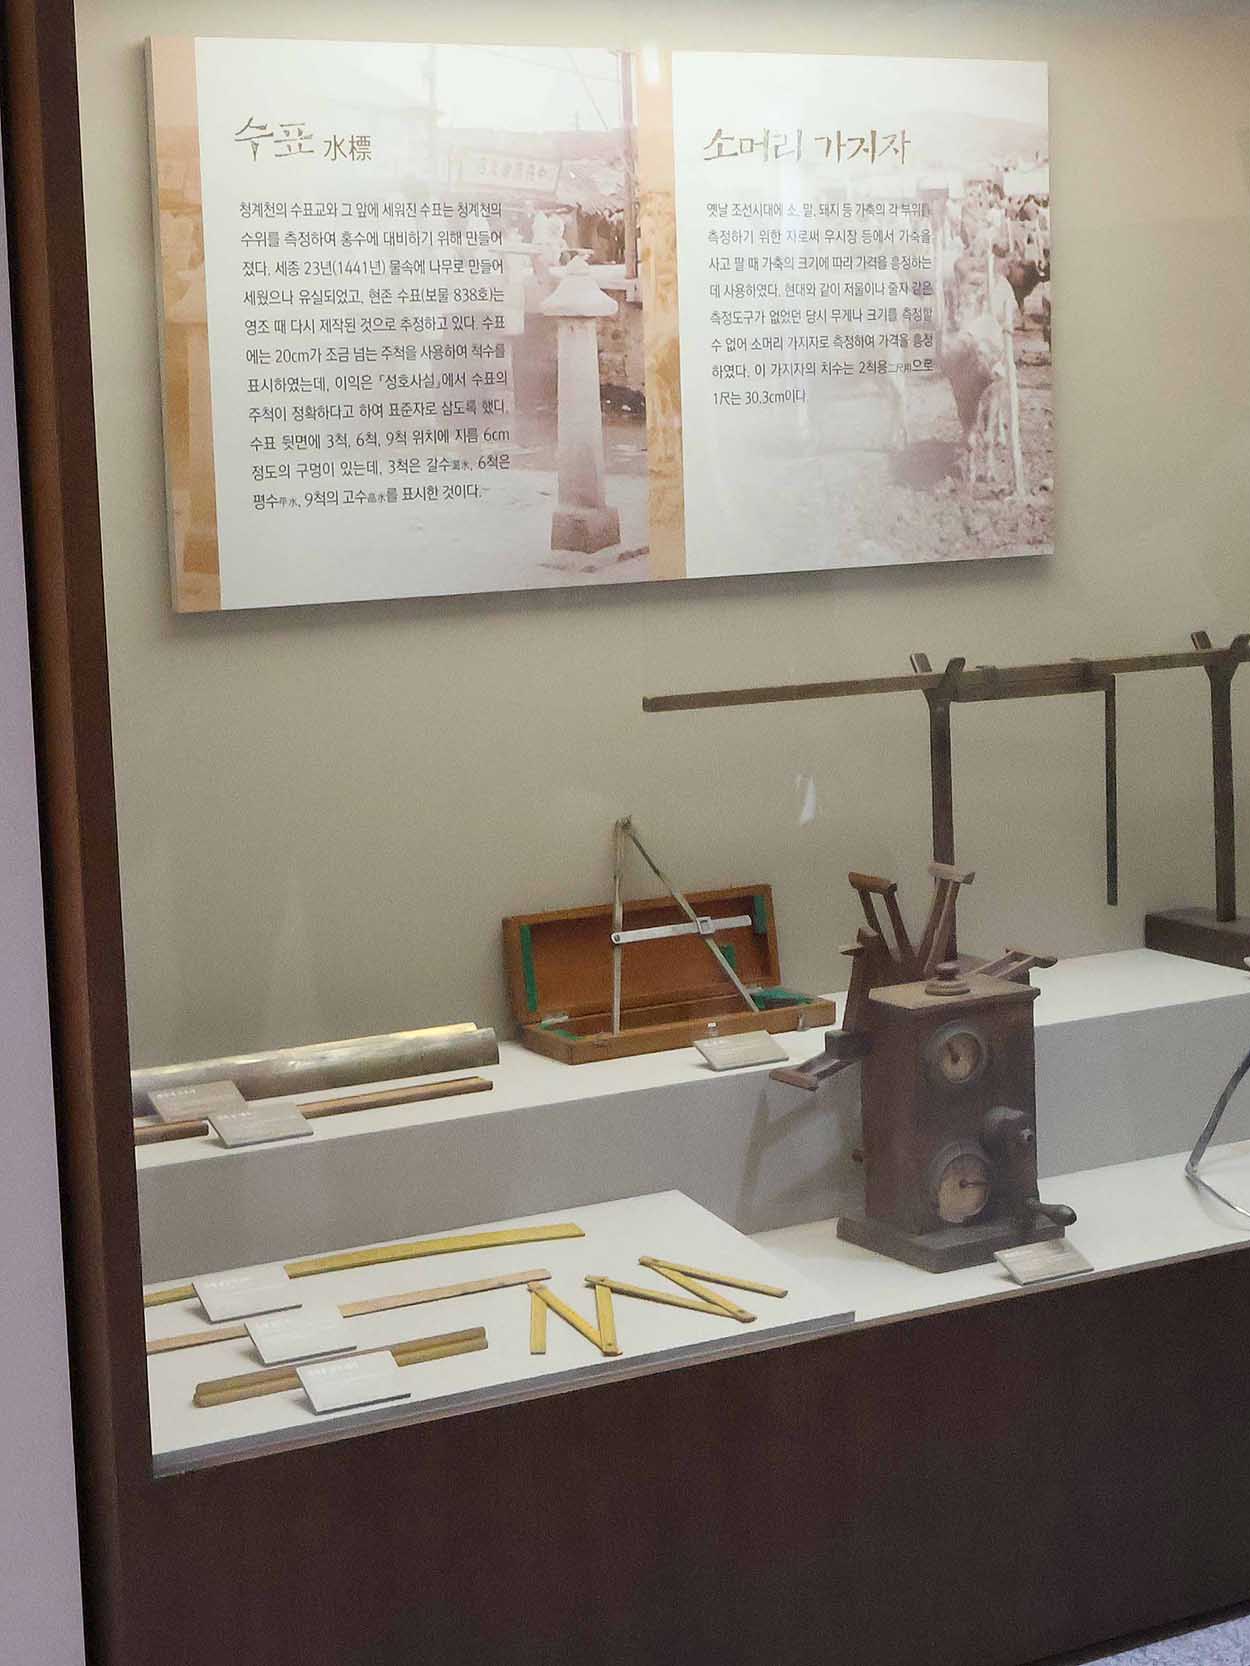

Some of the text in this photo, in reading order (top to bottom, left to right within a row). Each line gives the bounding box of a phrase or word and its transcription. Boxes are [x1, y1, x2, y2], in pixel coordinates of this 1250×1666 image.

[235, 116, 373, 162] 수표 水標
[703, 127, 912, 165] 소머리 가지자
[240, 201, 502, 218] 청계천의 수표교와 그 앞에 세워진 수표는 청계천의
[706, 203, 728, 217] 옛날
[731, 203, 783, 217] 조선시대에
[819, 203, 840, 217] 돼지
[842, 203, 852, 218] 등
[856, 203, 886, 218] 가축의
[889, 203, 898, 217] 각
[241, 231, 503, 248] 수위를 측정하여 홍수에 대비하기 위해 만들어
[708, 230, 754, 245] 측정하기
[760, 229, 781, 244] 위한
[824, 229, 857, 244] 우시장
[861, 229, 894, 244] 등에서
[242, 259, 503, 277] 졌다. 세종 23년(1441년) 물속에 나무로 만들어
[709, 257, 731, 271] 사고
[748, 257, 759, 271] 때
[762, 256, 794, 271] 가축의
[798, 256, 829, 271] 크기에
[856, 256, 887, 271] 가격을
[243, 289, 293, 306] 세웠으나
[369, 288, 392, 304] 현존
[397, 288, 449, 304] 수표(보물
[454, 288, 504, 303] 838호)는
[710, 284, 720, 298] 데
[785, 282, 816, 298] 현대와
[820, 282, 840, 297] 같이
[844, 282, 885, 297] 저울이나
[888, 281, 909, 297] 줄자
[245, 315, 505, 336] 영조 때 다시 제작된 것으로 추정하고 있다. 수표
[710, 310, 766, 326] 측정도구가
[769, 309, 801, 325] 없었던
[806, 308, 827, 324] 당시
[831, 308, 863, 323] 무게나
[711, 338, 722, 352] 수
[725, 337, 747, 352] 없어
[751, 336, 783, 351] 소머리
[788, 336, 830, 351] 가지자로
[833, 334, 875, 350] 측정하여
[246, 349, 271, 365] 에는
[275, 347, 321, 364] 20cm가
[326, 347, 349, 363] 조금
[353, 346, 377, 362] 넘는
[381, 344, 416, 361] 주척을
[420, 343, 468, 360] 사용하여
[712, 364, 750, 379] 하였다.
[754, 363, 765, 378] 이
[771, 362, 816, 377] 가지자의
[821, 361, 854, 376] 치수는
[335, 374, 373, 391] 이익은
[471, 371, 507, 387] 수표의
[713, 391, 742, 406] 1尺는
[249, 406, 287, 423] 주척이
[292, 404, 354, 422] 정확하다고
[359, 403, 383, 419] 하여
[388, 401, 436, 418] 표준자로
[250, 436, 276, 452] 수표
[282, 434, 321, 450] 뒷면에
[386, 430, 407, 446] 9척
[413, 429, 449, 445] 위치에
[455, 428, 478, 443] 지름
[483, 426, 510, 442] 6cm
[252, 464, 291, 481] 정도의
[296, 462, 334, 479] 구멍이
[388, 458, 421, 474] 3척은
[478, 454, 510, 470] 6척은
[304, 490, 338, 507] 9척의
[401, 485, 438, 501] 표시한
[442, 483, 482, 499] 것이다.
